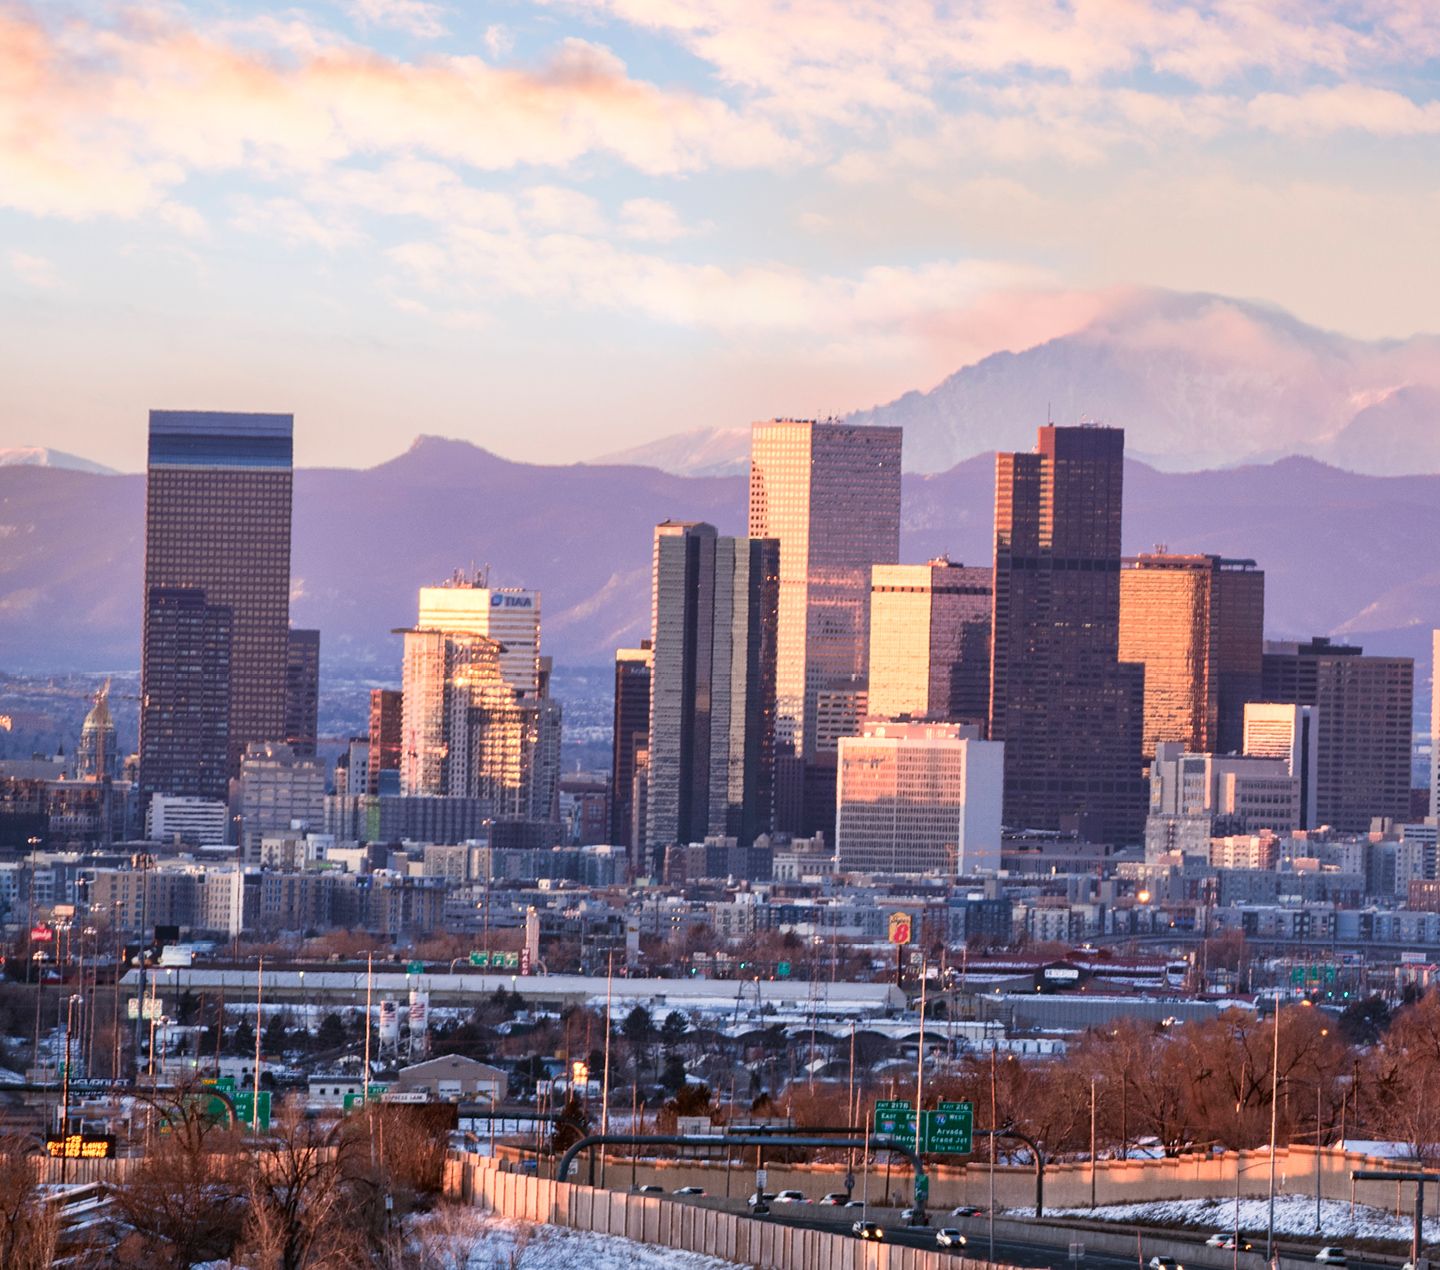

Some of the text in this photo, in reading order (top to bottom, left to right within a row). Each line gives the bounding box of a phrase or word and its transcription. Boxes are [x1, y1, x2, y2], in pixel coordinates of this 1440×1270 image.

[504, 596, 532, 607] TIAA
[894, 924, 909, 943] 8
[937, 1127, 963, 1135] Arvada
[895, 1135, 924, 1143] Morgn
[931, 1135, 953, 1143] Grand
